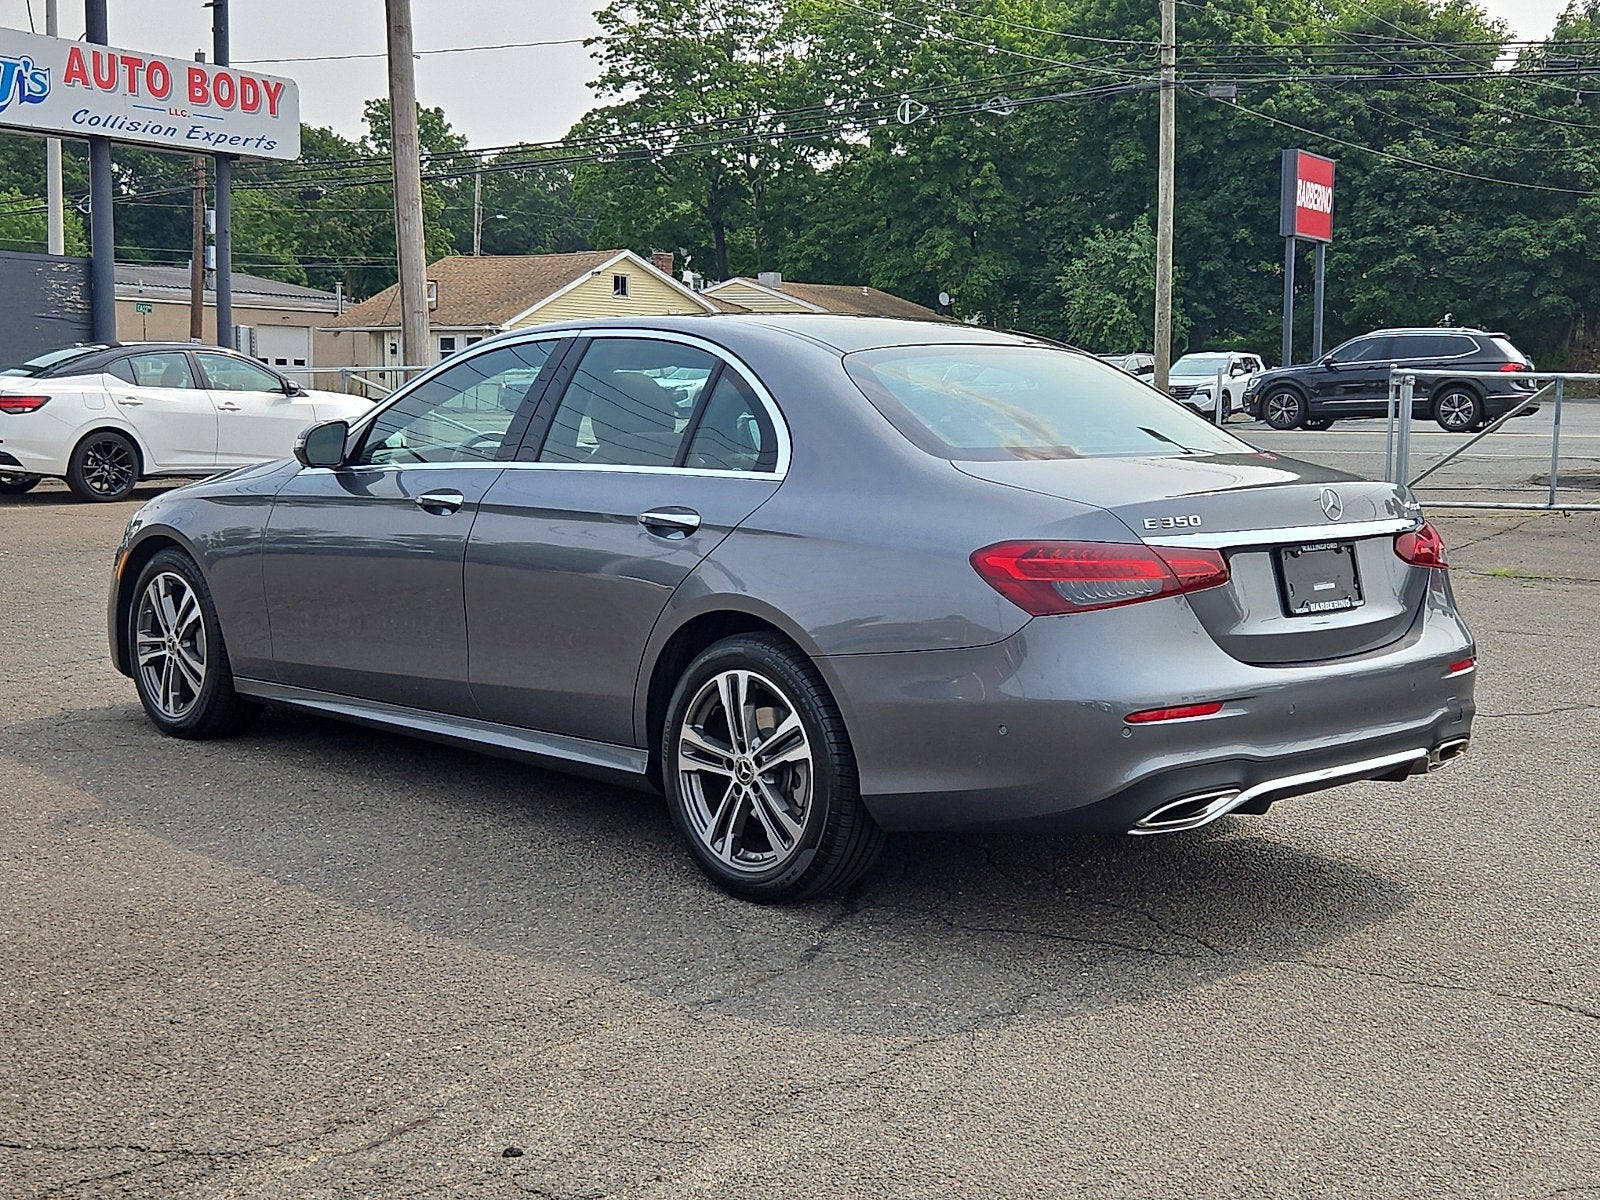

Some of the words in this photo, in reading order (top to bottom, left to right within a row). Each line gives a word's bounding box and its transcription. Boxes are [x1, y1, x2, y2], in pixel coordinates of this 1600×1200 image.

[63, 46, 172, 99] AUTO
[187, 66, 284, 117] BODY
[72, 109, 178, 138] Collision
[185, 125, 279, 151] Experts
[1296, 179, 1332, 214] BARBERINO
[1143, 518, 1158, 529] E
[1160, 515, 1202, 528] 350
[1310, 600, 1351, 612] BARBERINO
